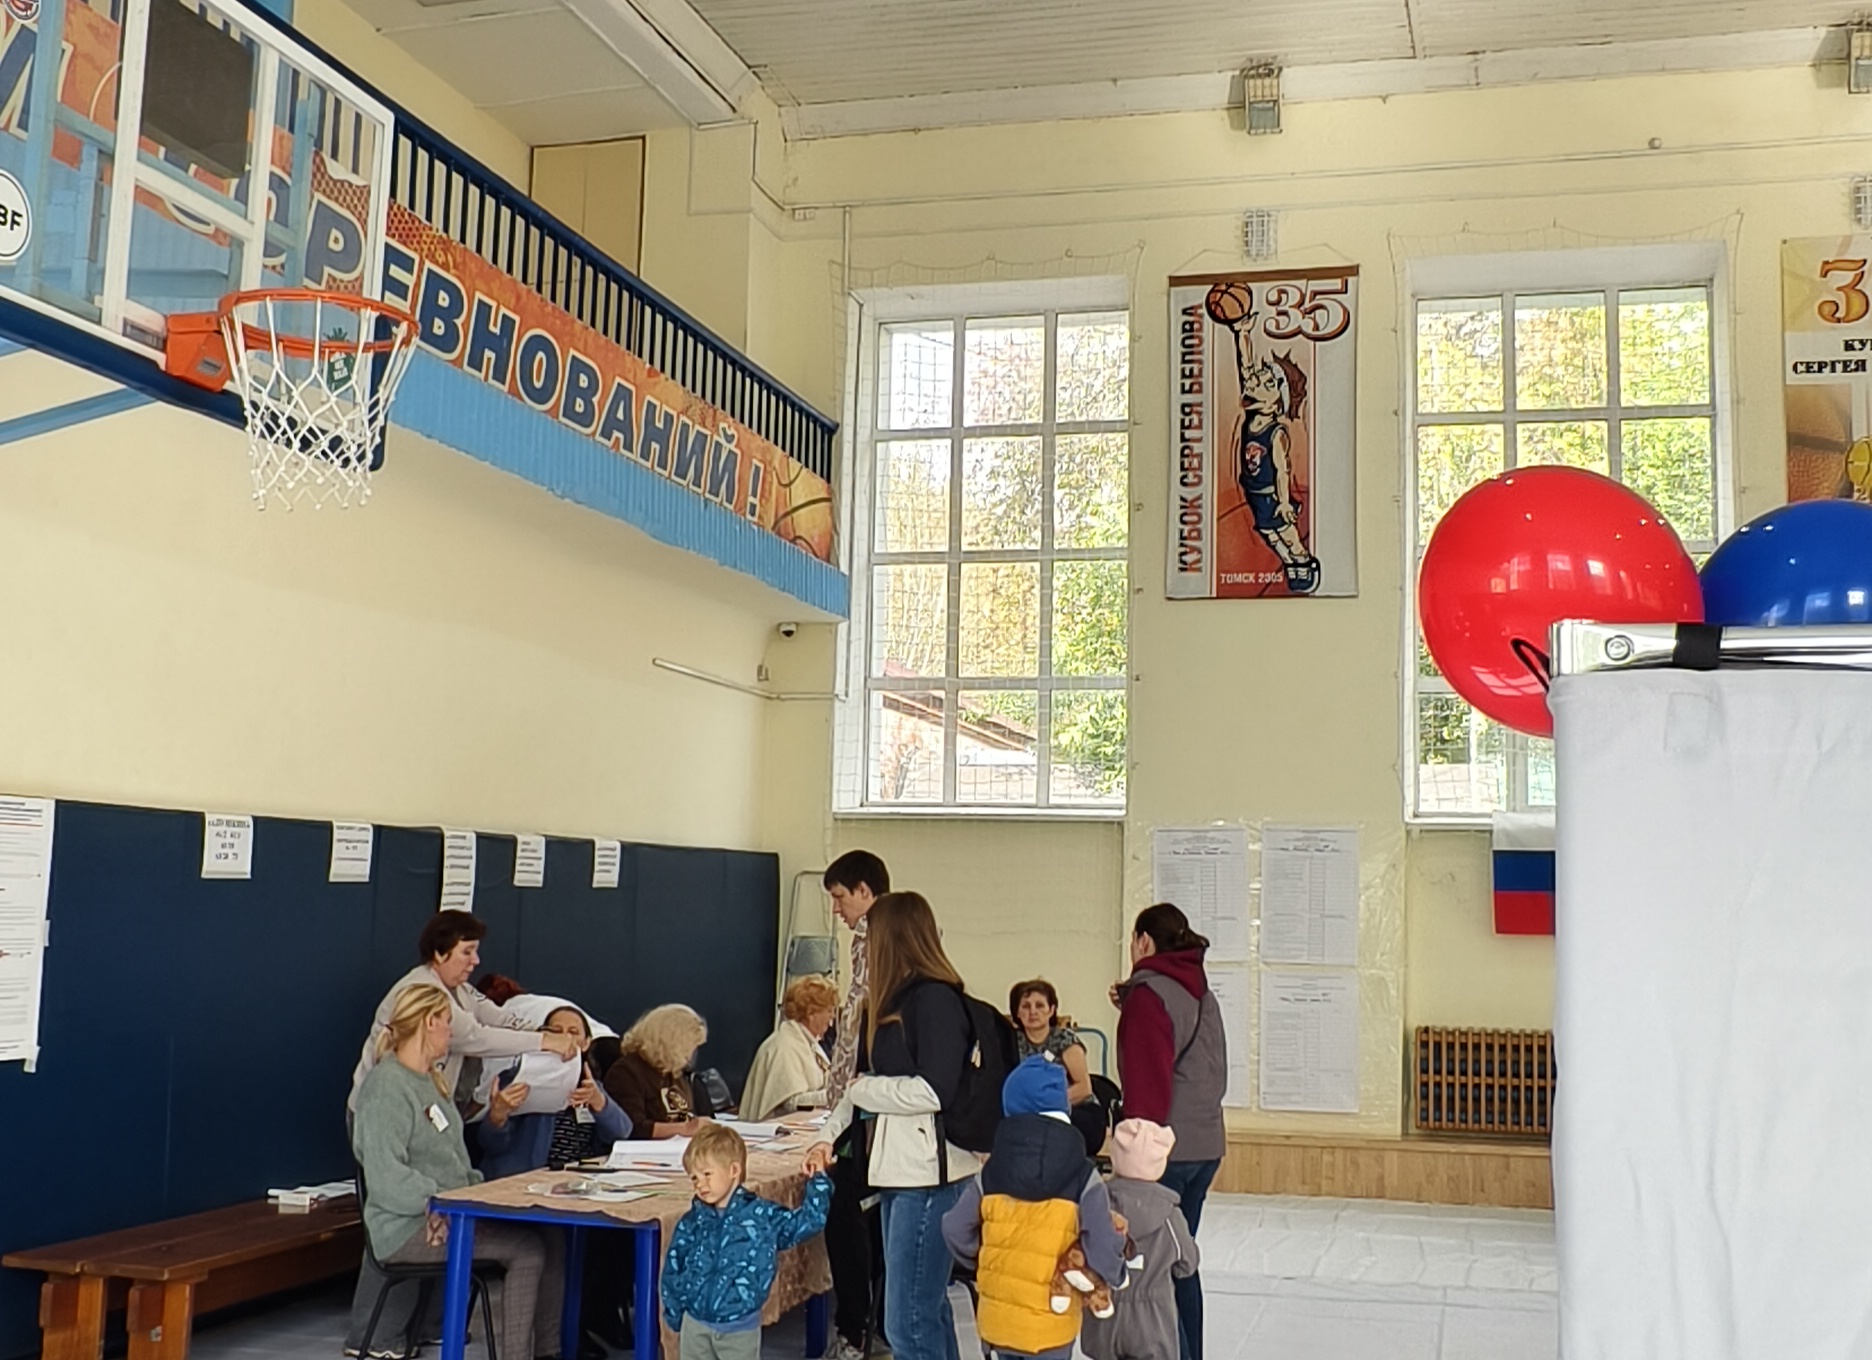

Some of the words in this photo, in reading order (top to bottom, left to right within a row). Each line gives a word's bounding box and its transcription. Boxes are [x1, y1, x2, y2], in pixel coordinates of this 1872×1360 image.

[1263, 277, 1351, 342] 35
[1180, 302, 1204, 395] БЕЛОВА
[1792, 359, 1867, 374] СЕРГЕЯ
[1843, 339, 1872, 352] КУ
[1179, 400, 1204, 488] СЕРГЕЯ
[1177, 493, 1204, 573] КУБОК
[1219, 573, 1256, 584] ТОМСК
